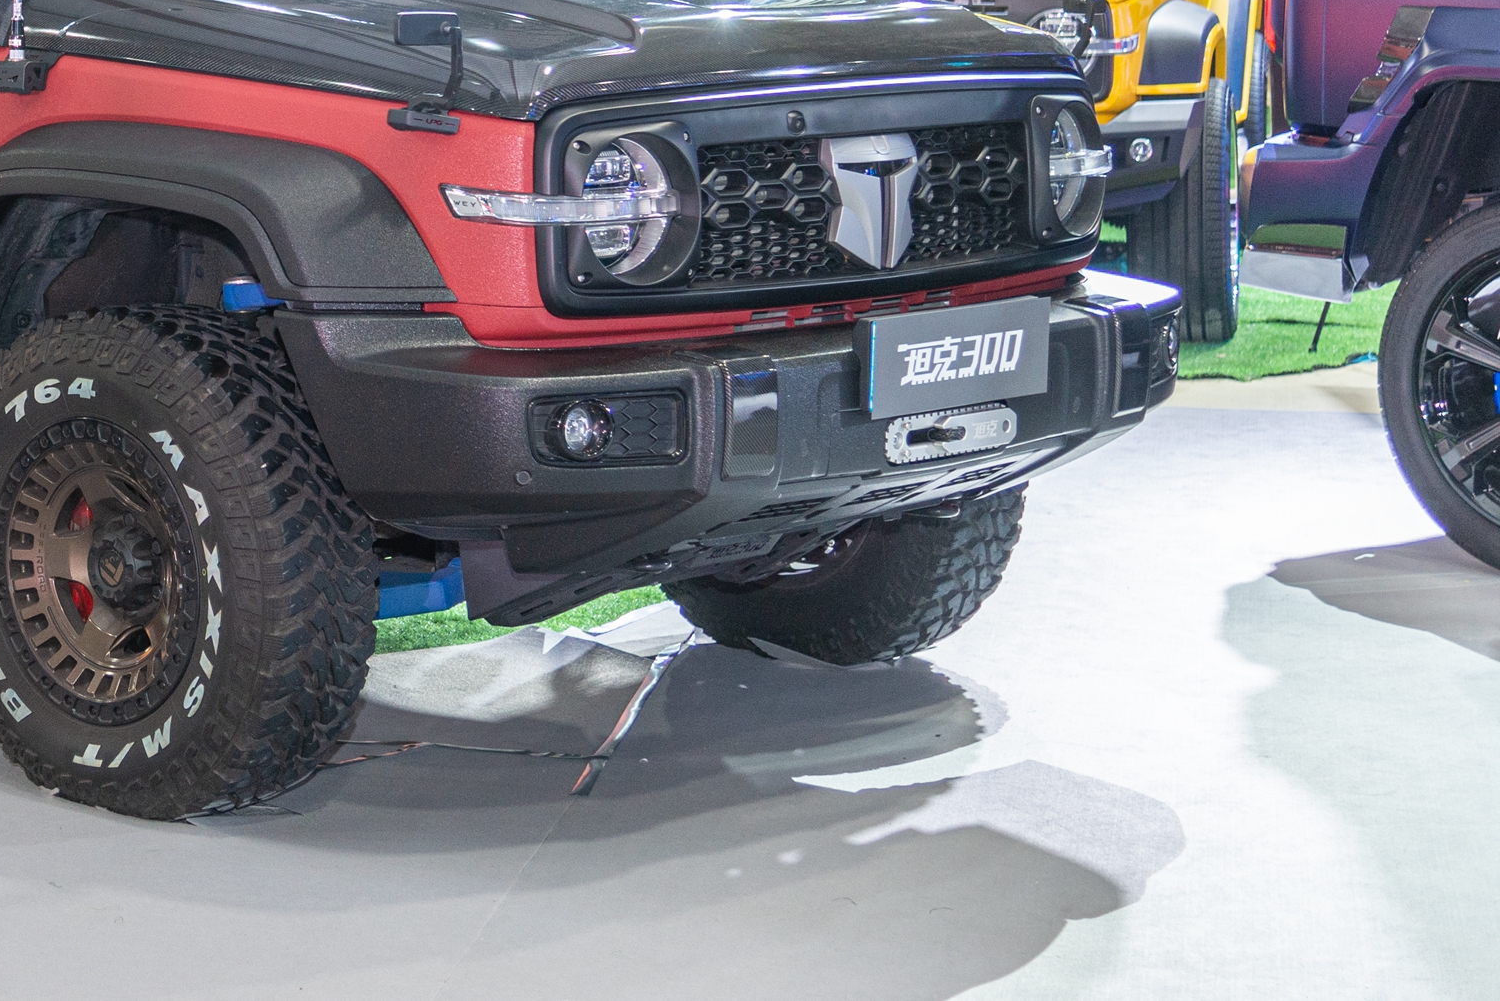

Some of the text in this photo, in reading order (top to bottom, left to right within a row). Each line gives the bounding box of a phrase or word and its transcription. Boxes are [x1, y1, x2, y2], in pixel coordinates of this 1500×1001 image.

[897, 329, 1024, 387] 坦克300
[5, 377, 97, 423] 764
[971, 419, 998, 440] 坦克
[72, 429, 223, 769] MAXXIS M/T
